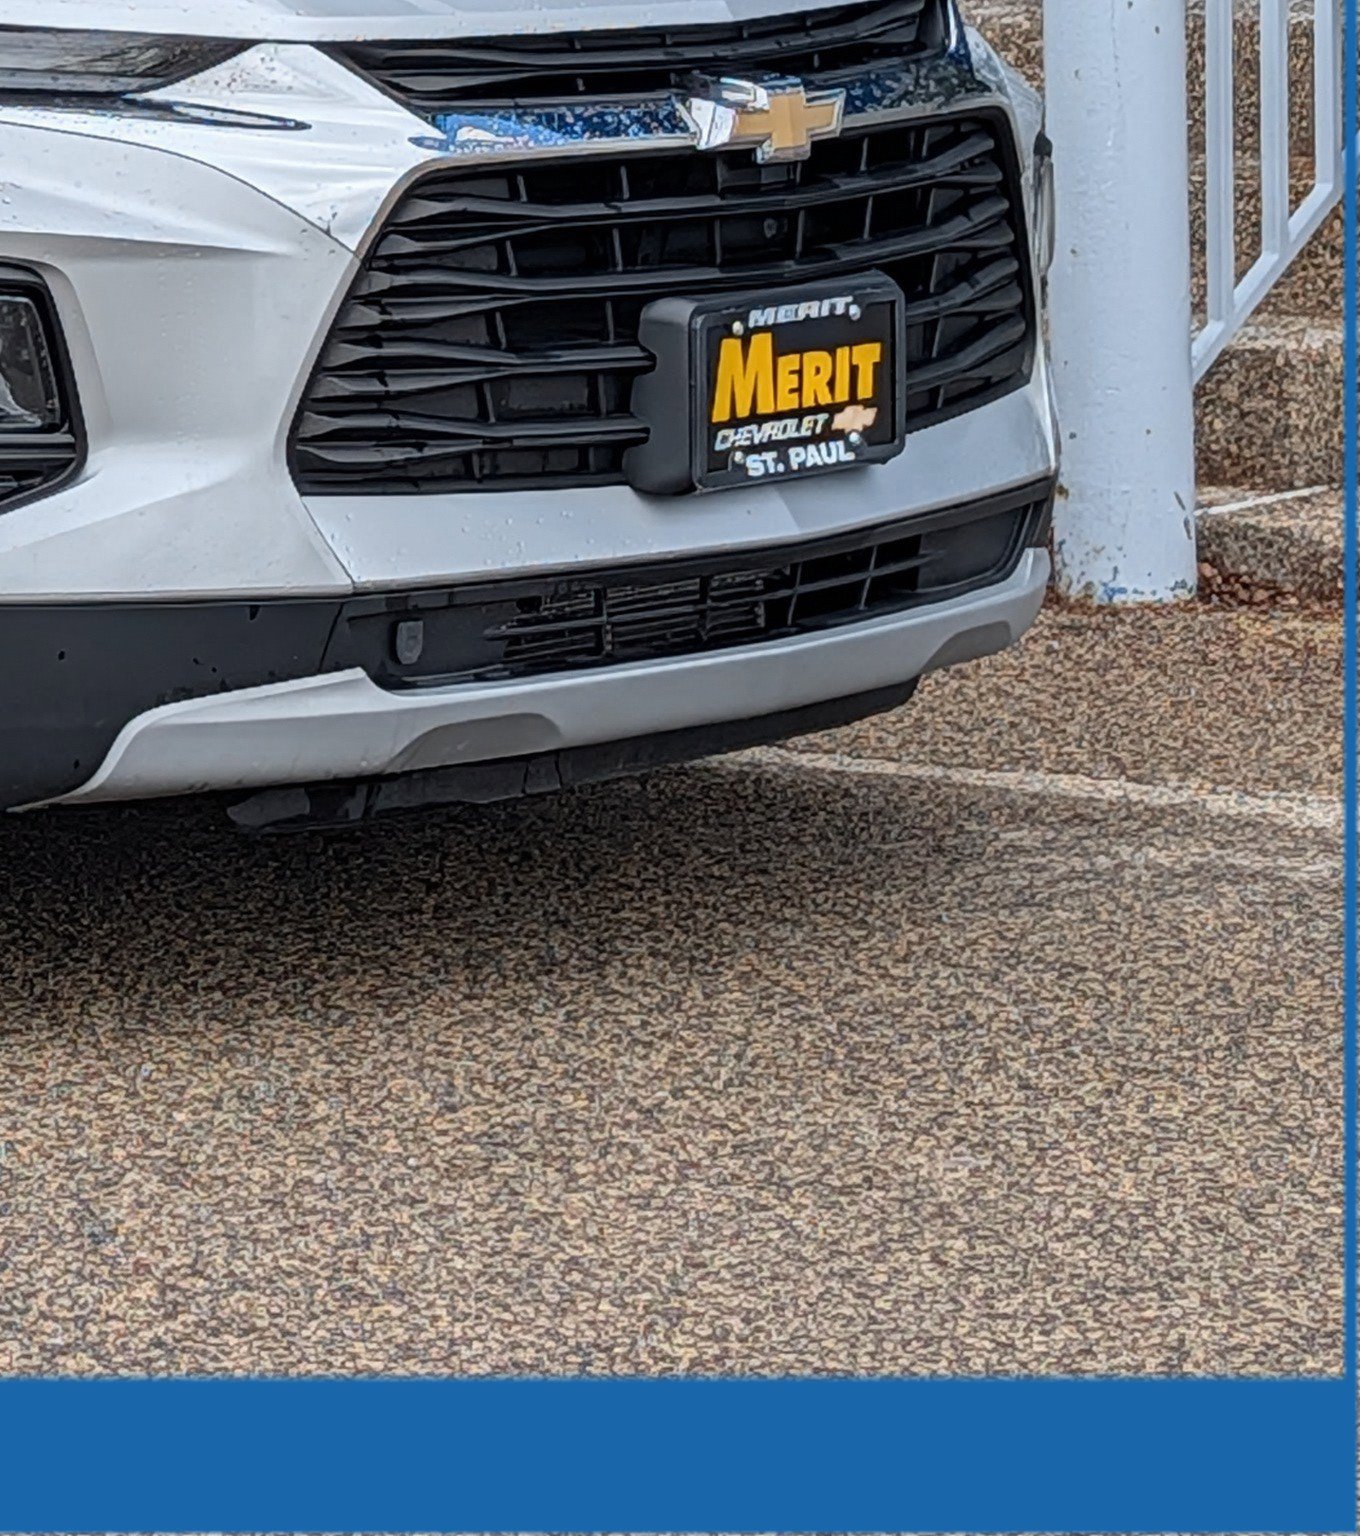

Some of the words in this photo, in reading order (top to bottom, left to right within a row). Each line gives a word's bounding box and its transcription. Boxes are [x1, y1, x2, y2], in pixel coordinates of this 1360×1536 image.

[714, 413, 829, 452] CHEVROLET
[745, 451, 786, 477] ST.
[788, 440, 855, 470] PAUL
